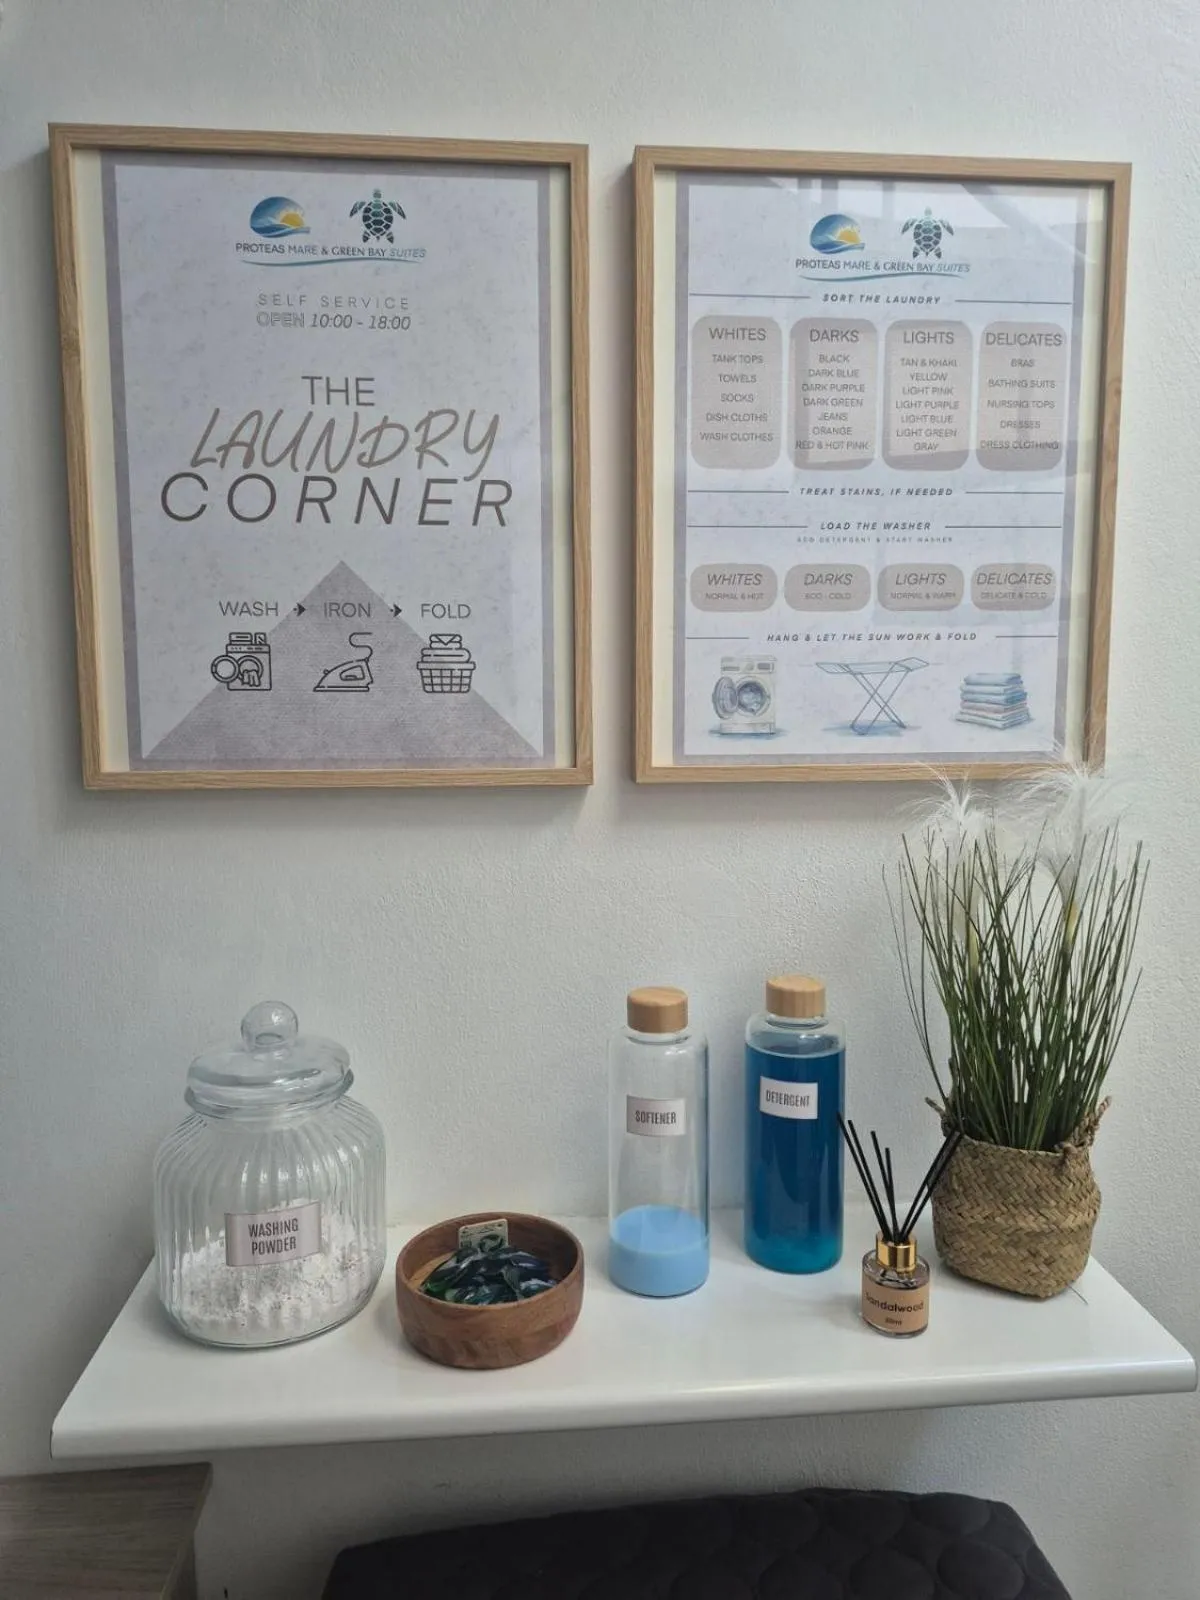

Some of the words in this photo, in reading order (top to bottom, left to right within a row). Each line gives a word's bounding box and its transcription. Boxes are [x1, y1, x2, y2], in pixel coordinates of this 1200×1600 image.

[235, 243, 285, 254] PROTEAS
[288, 246, 318, 255] MARE
[321, 247, 329, 255] &
[332, 246, 365, 256] GREEN
[368, 247, 386, 257] BAY
[389, 248, 427, 258] SUITES
[795, 259, 841, 269] PROTEAS
[843, 261, 871, 270] MARE
[873, 261, 881, 270] &
[883, 261, 914, 272] GREEN
[917, 263, 934, 272] BAY
[936, 263, 970, 272] SUITES
[257, 293, 306, 306] SELF
[321, 296, 409, 310] SERVICE
[823, 294, 854, 302] SORT
[886, 296, 941, 304] LAUNDRY
[256, 312, 305, 328] OPEN
[311, 314, 352, 329] 10:00
[368, 316, 411, 330] 18:00
[709, 328, 767, 341] WHITES
[809, 329, 859, 343] DARKS
[903, 331, 954, 344] LIGHTS
[986, 332, 1062, 346] DELICATES
[712, 354, 736, 363] TANK
[738, 355, 764, 363] TOPS
[818, 354, 850, 363] BLACK
[901, 359, 918, 367] TAN
[920, 359, 927, 367] &
[928, 359, 957, 367] KHAKI
[1011, 359, 1035, 367] BRAS
[719, 374, 757, 383] TOWELS
[808, 369, 834, 377] DARK
[836, 369, 859, 378] BLUE
[910, 373, 948, 381] YELLOW
[801, 384, 828, 392] DARK
[830, 384, 865, 393] PURPLE
[988, 379, 1028, 388] BATHING
[1030, 380, 1056, 388] SUITS
[301, 376, 375, 407] THE
[902, 387, 929, 395] LIGHT
[931, 387, 954, 395] PINK
[720, 393, 754, 403] SOCKS
[803, 398, 829, 406] DARK
[831, 399, 863, 407] GREEN
[896, 401, 923, 409] LIGHT
[924, 401, 959, 409] PURPLE
[987, 400, 1028, 409] NURSING
[1030, 400, 1055, 409] TOPS
[706, 413, 729, 422] DISH
[731, 413, 768, 422] CLOTHS
[817, 412, 848, 421] JEANS
[901, 415, 928, 423] LIGHT
[930, 415, 953, 423] BLUE
[1000, 420, 1041, 429] DRESSES
[812, 427, 852, 435] ORANGE
[896, 429, 923, 437] LIGHT
[924, 429, 957, 437] GREEN
[700, 432, 728, 441] WASH
[730, 433, 774, 442] CLOTHES
[189, 407, 501, 482] LAUNDRY
[796, 440, 813, 449] RED
[817, 441, 823, 449] &
[825, 441, 844, 450] HOT
[846, 441, 868, 450] PINK
[914, 443, 939, 451] GRAY
[980, 440, 1010, 449] DRESS
[1012, 441, 1059, 450] CLOTHING
[840, 488, 885, 497] STAINS,
[906, 488, 953, 496] NEEDED
[160, 471, 513, 527] CORNER
[820, 522, 851, 530] LOAD
[856, 522, 877, 530] THE
[883, 522, 931, 530] WASHER
[707, 573, 763, 586] WHITES
[804, 573, 853, 586] DARKS
[895, 572, 947, 586] LIGHTS
[977, 572, 1053, 585] DELICATES
[705, 592, 739, 600] NORMAL
[828, 592, 851, 600] COLD
[981, 592, 1016, 600] DELICATE
[1024, 592, 1047, 600] COLD
[219, 601, 279, 618] WASH
[323, 602, 371, 619] IRON
[421, 603, 471, 619] FOLD
[767, 634, 799, 642] HANG
[842, 633, 863, 641] THE
[765, 1089, 810, 1107] DETERGENT
[635, 1110, 677, 1124] SOFTENER
[248, 1218, 298, 1237] WASHING
[251, 1236, 296, 1256] POWDER
